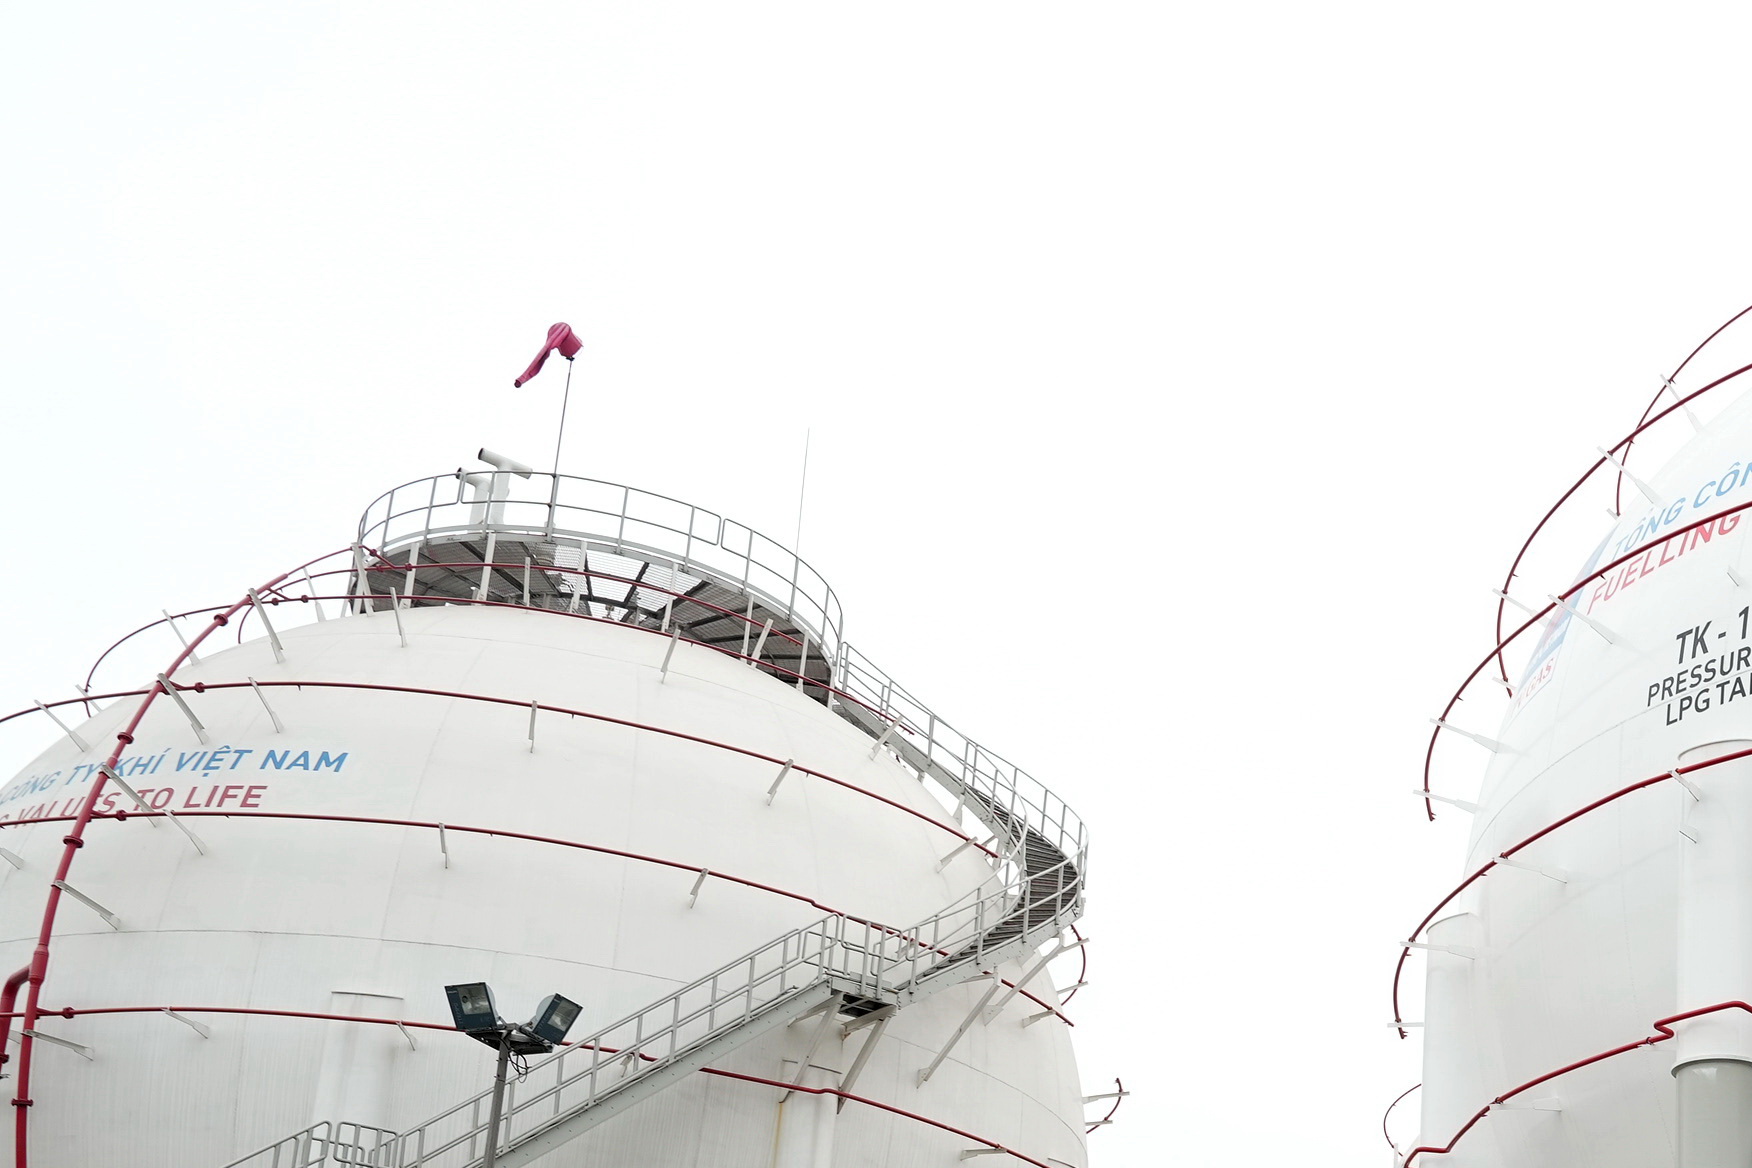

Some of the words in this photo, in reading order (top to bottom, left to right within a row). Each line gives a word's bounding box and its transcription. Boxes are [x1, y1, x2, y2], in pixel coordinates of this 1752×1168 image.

[1586, 512, 1741, 616] FUELLING
[1676, 620, 1713, 665] TK
[1665, 688, 1711, 727] LPG
[65, 761, 107, 786] TY
[113, 746, 173, 778] KHÍ
[174, 744, 254, 778] VIỆT
[260, 749, 349, 773] NAM
[14, 791, 122, 829] VALUS
[132, 786, 175, 812] TO
[183, 784, 268, 809] LIFE
